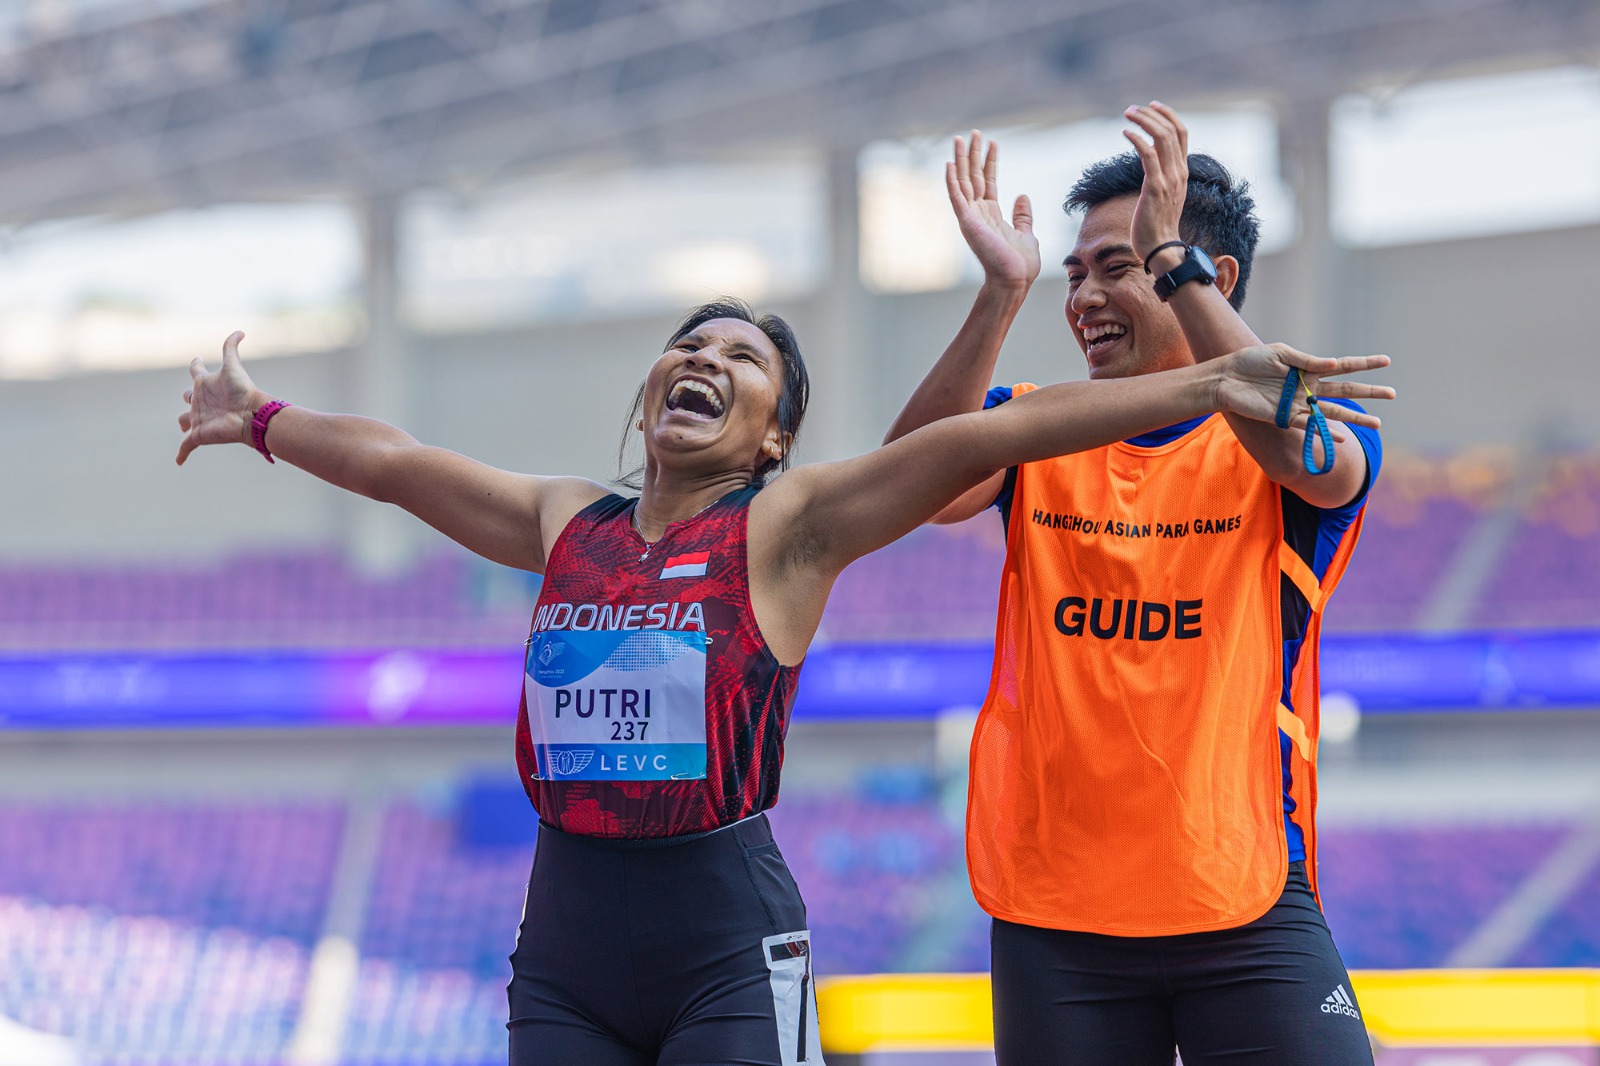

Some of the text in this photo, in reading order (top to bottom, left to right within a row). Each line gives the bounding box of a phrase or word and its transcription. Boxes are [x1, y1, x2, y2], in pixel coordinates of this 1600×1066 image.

[1104, 519, 1151, 538] ASIAN
[1156, 520, 1190, 538] PARA
[1193, 514, 1242, 535] GAMES
[532, 602, 706, 631] INDONESIA
[1054, 596, 1203, 641] GUIDE
[555, 689, 651, 718] PUTRI
[611, 721, 649, 741] 237
[600, 754, 668, 772] LEVC
[1320, 1002, 1360, 1020] adidas
